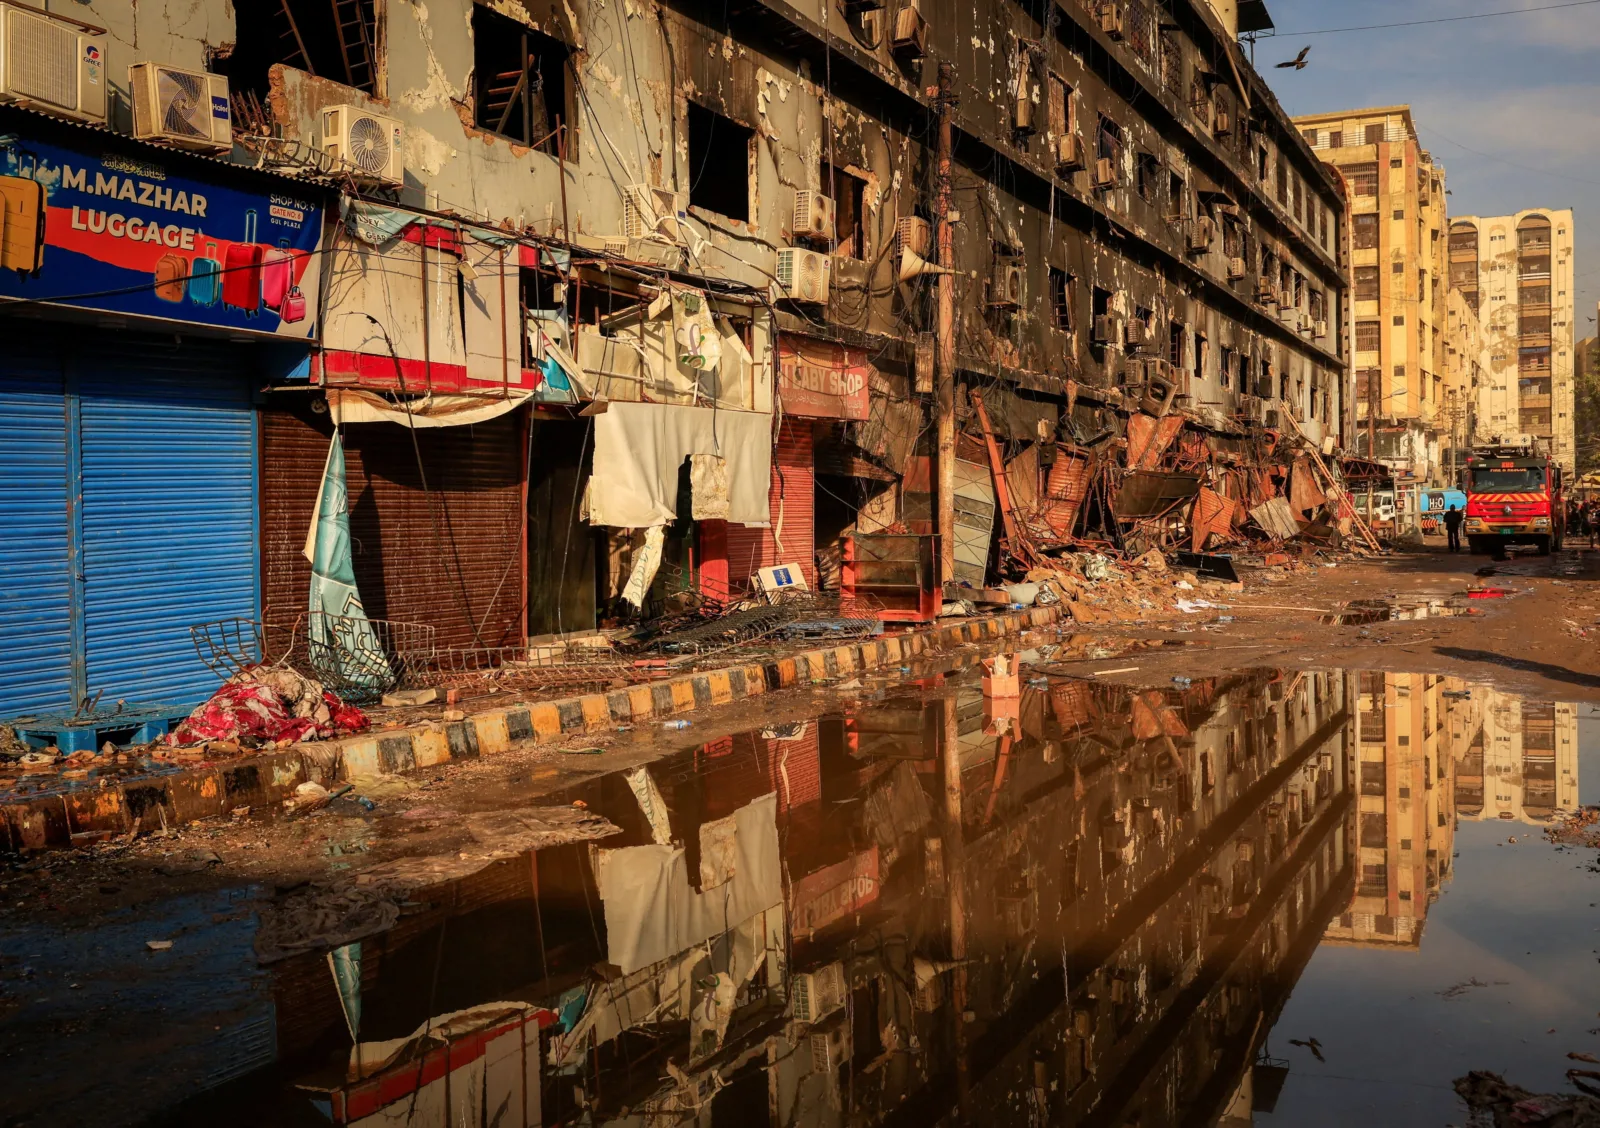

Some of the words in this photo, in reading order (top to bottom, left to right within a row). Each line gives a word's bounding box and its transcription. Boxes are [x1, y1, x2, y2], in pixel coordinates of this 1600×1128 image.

[83, 56, 101, 68] GREE
[62, 164, 208, 218] M.MAZHAR
[270, 194, 293, 207] SHOP
[294, 199, 308, 210] NO:
[310, 202, 316, 212] 9
[272, 207, 286, 216] GATE
[71, 205, 196, 250] LUGGAGE
[283, 220, 300, 230] PLAZA
[830, 370, 862, 397] SHOP
